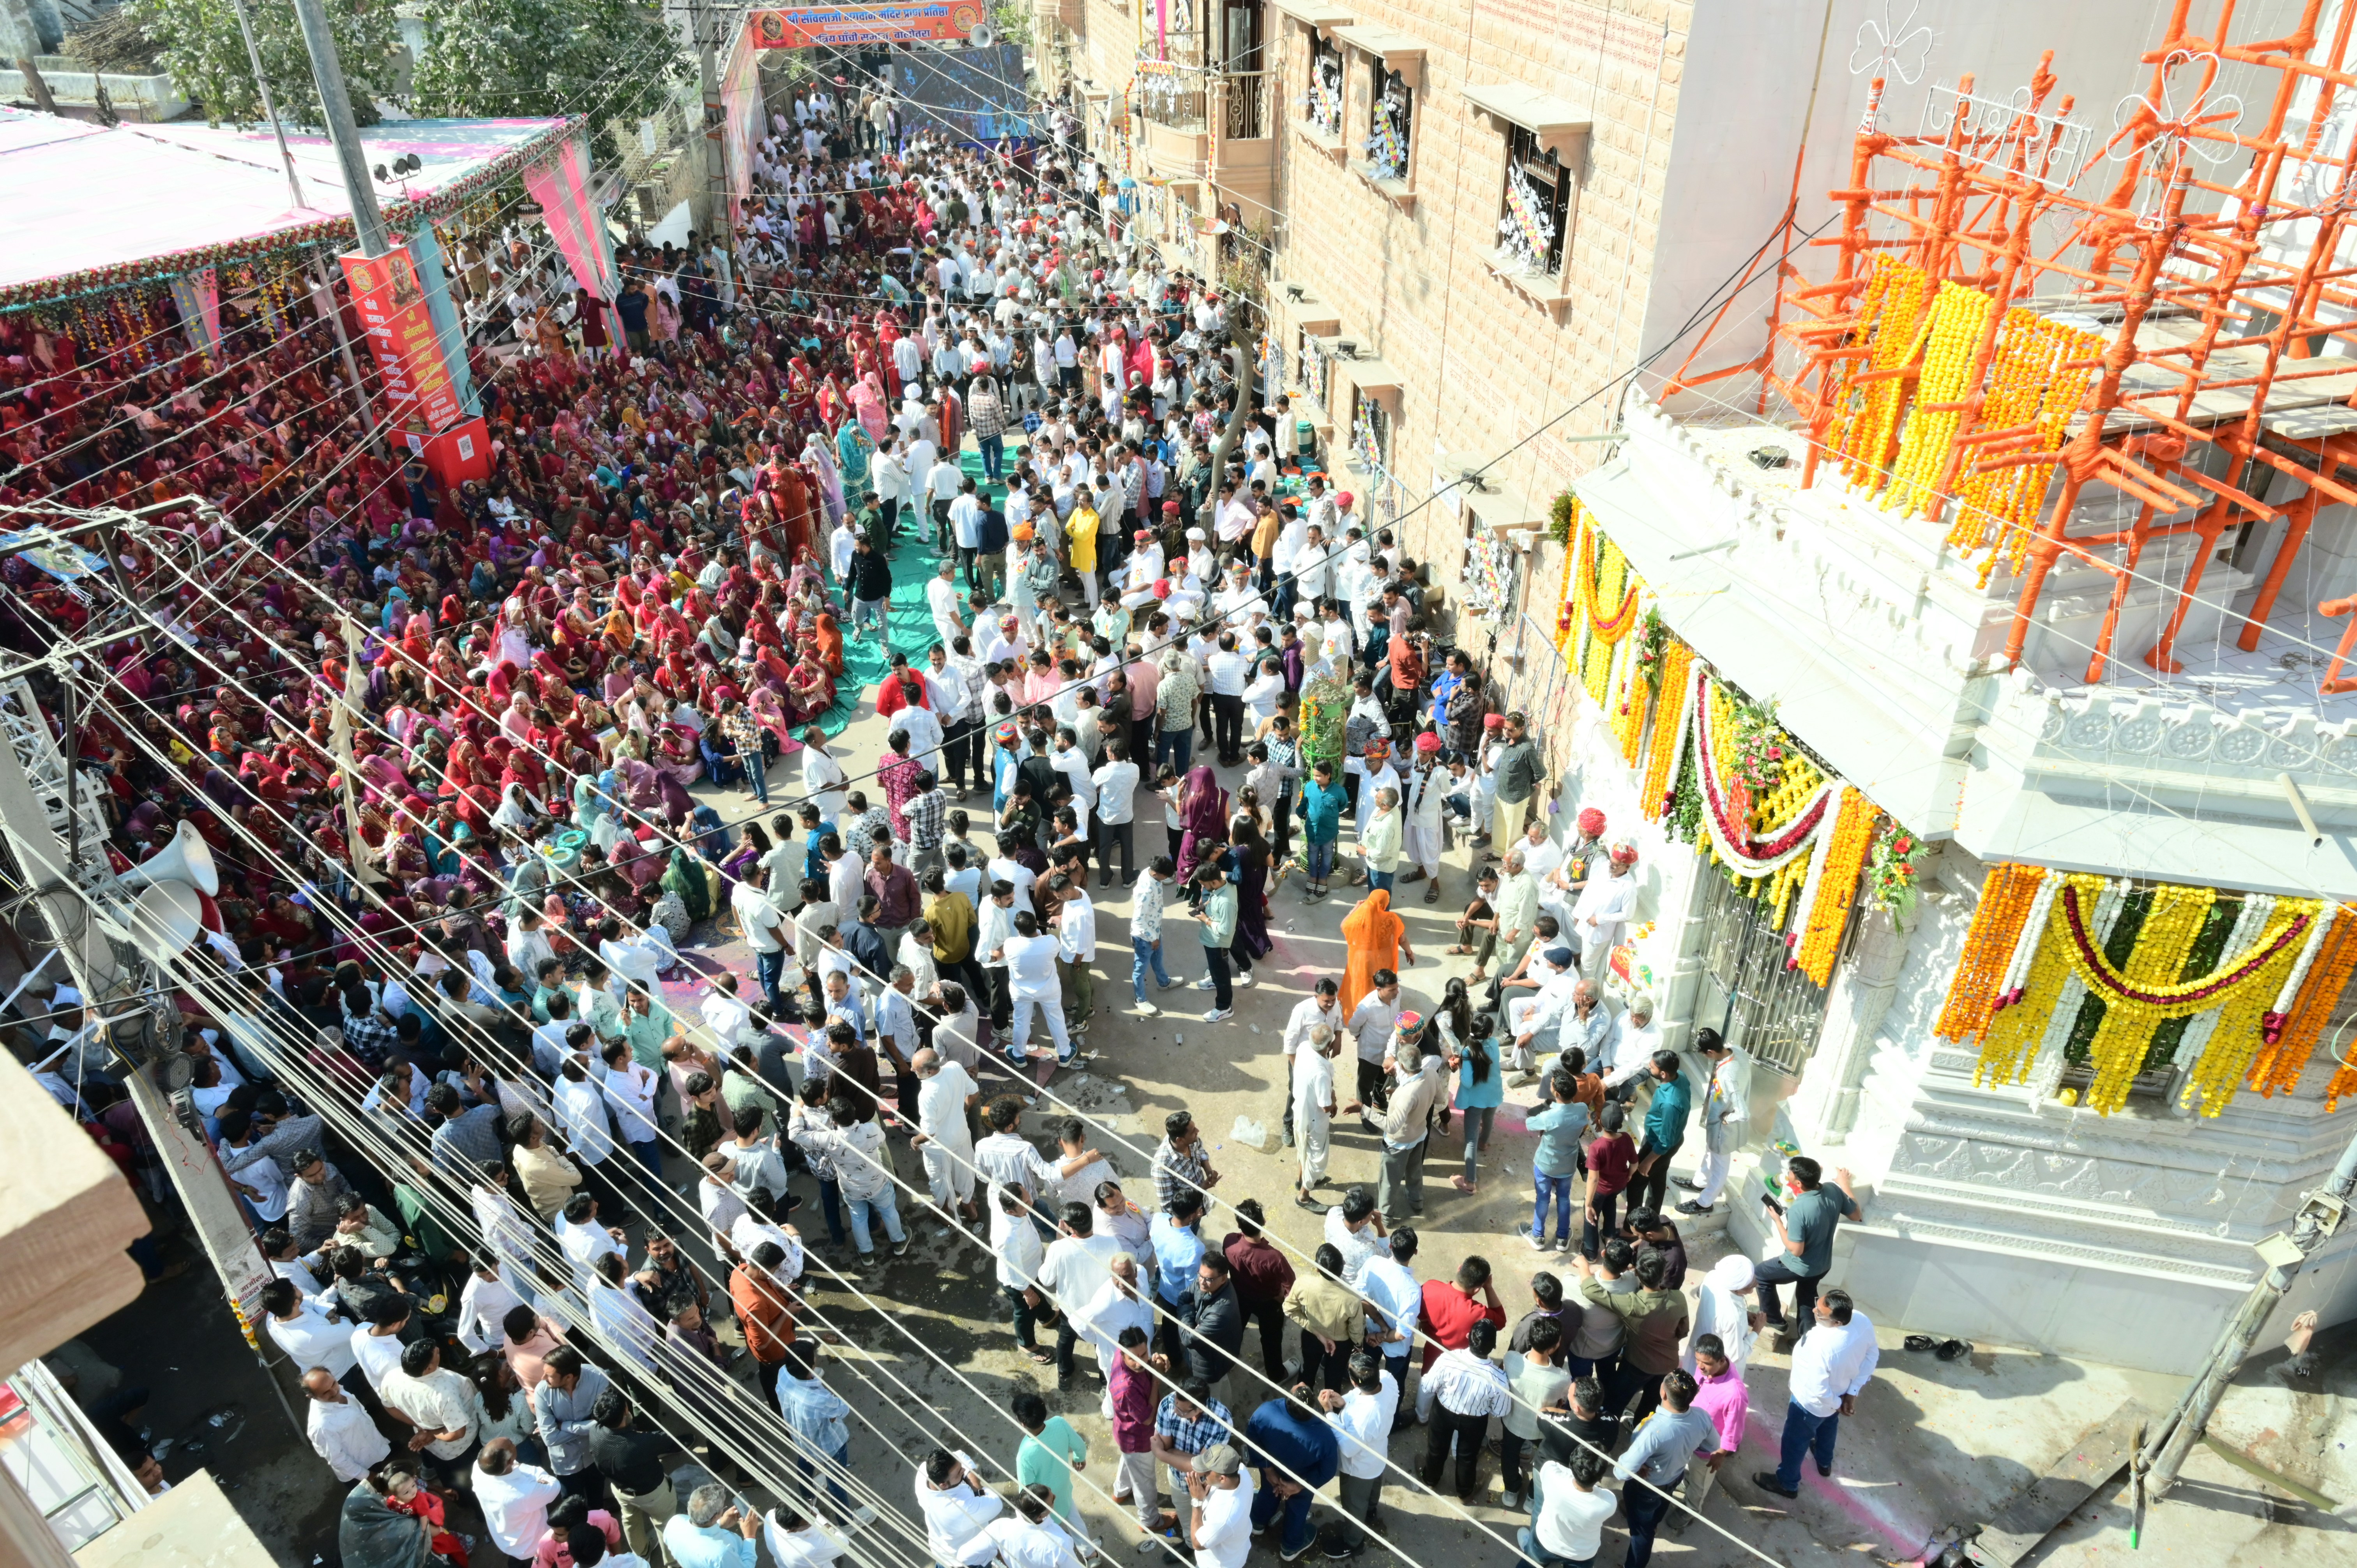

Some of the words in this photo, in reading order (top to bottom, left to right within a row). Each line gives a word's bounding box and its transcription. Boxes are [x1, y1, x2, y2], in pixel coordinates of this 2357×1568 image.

[923, 5, 948, 17] प्रतिष्ठा
[838, 31, 858, 42] घाँची
[364, 298, 378, 310] घाँची
[366, 314, 385, 323] समाज
[407, 309, 415, 322] श्री
[403, 320, 429, 340] साँवलाजी
[380, 354, 399, 363] आपका
[428, 410, 440, 421] घाँची
[439, 403, 456, 416] समाज
[239, 1273, 264, 1293] माजीसा
[238, 1286, 260, 1303] मेडिकल
[259, 1276, 273, 1288] स्टोर
